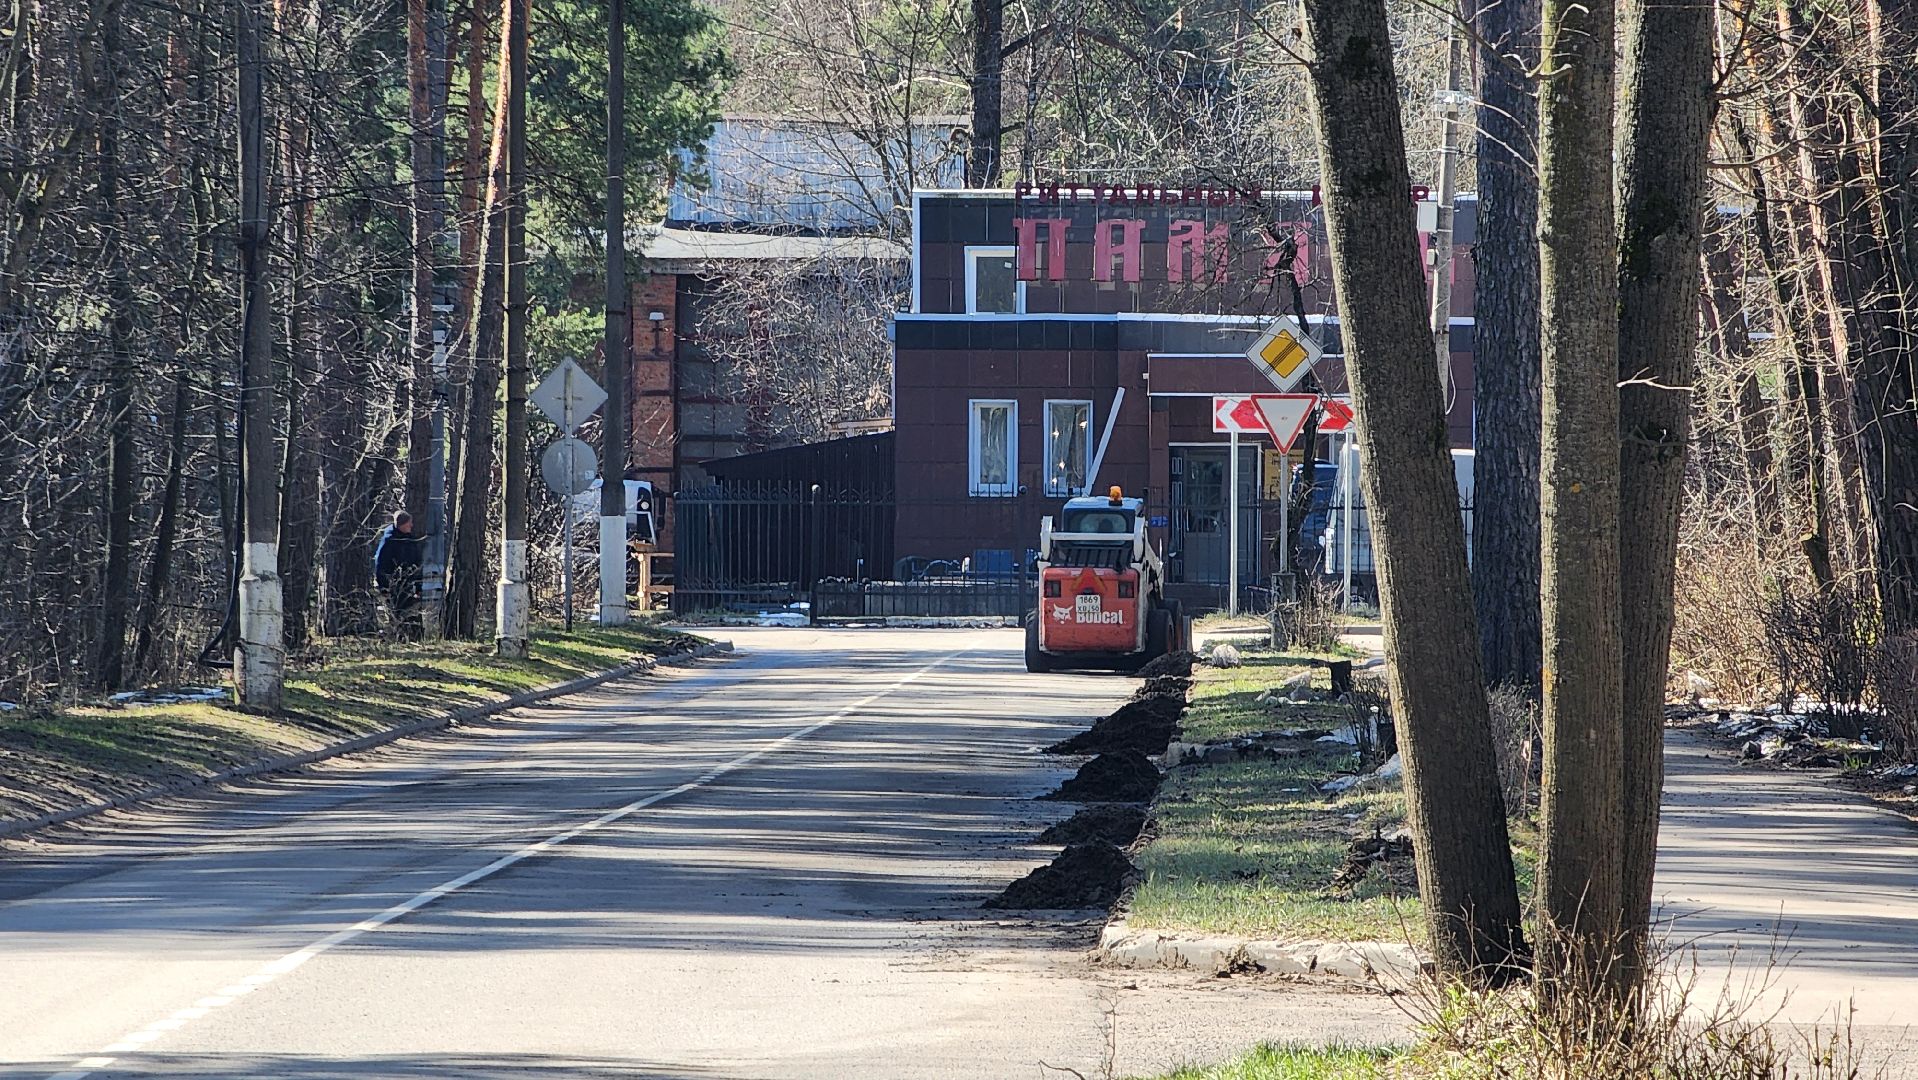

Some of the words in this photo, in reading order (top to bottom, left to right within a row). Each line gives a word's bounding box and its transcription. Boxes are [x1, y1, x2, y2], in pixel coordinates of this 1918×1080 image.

[1013, 218, 1455, 284] ПАМЯ
[1079, 596, 1099, 604] 1869
[1076, 610, 1123, 624] Bobcat
